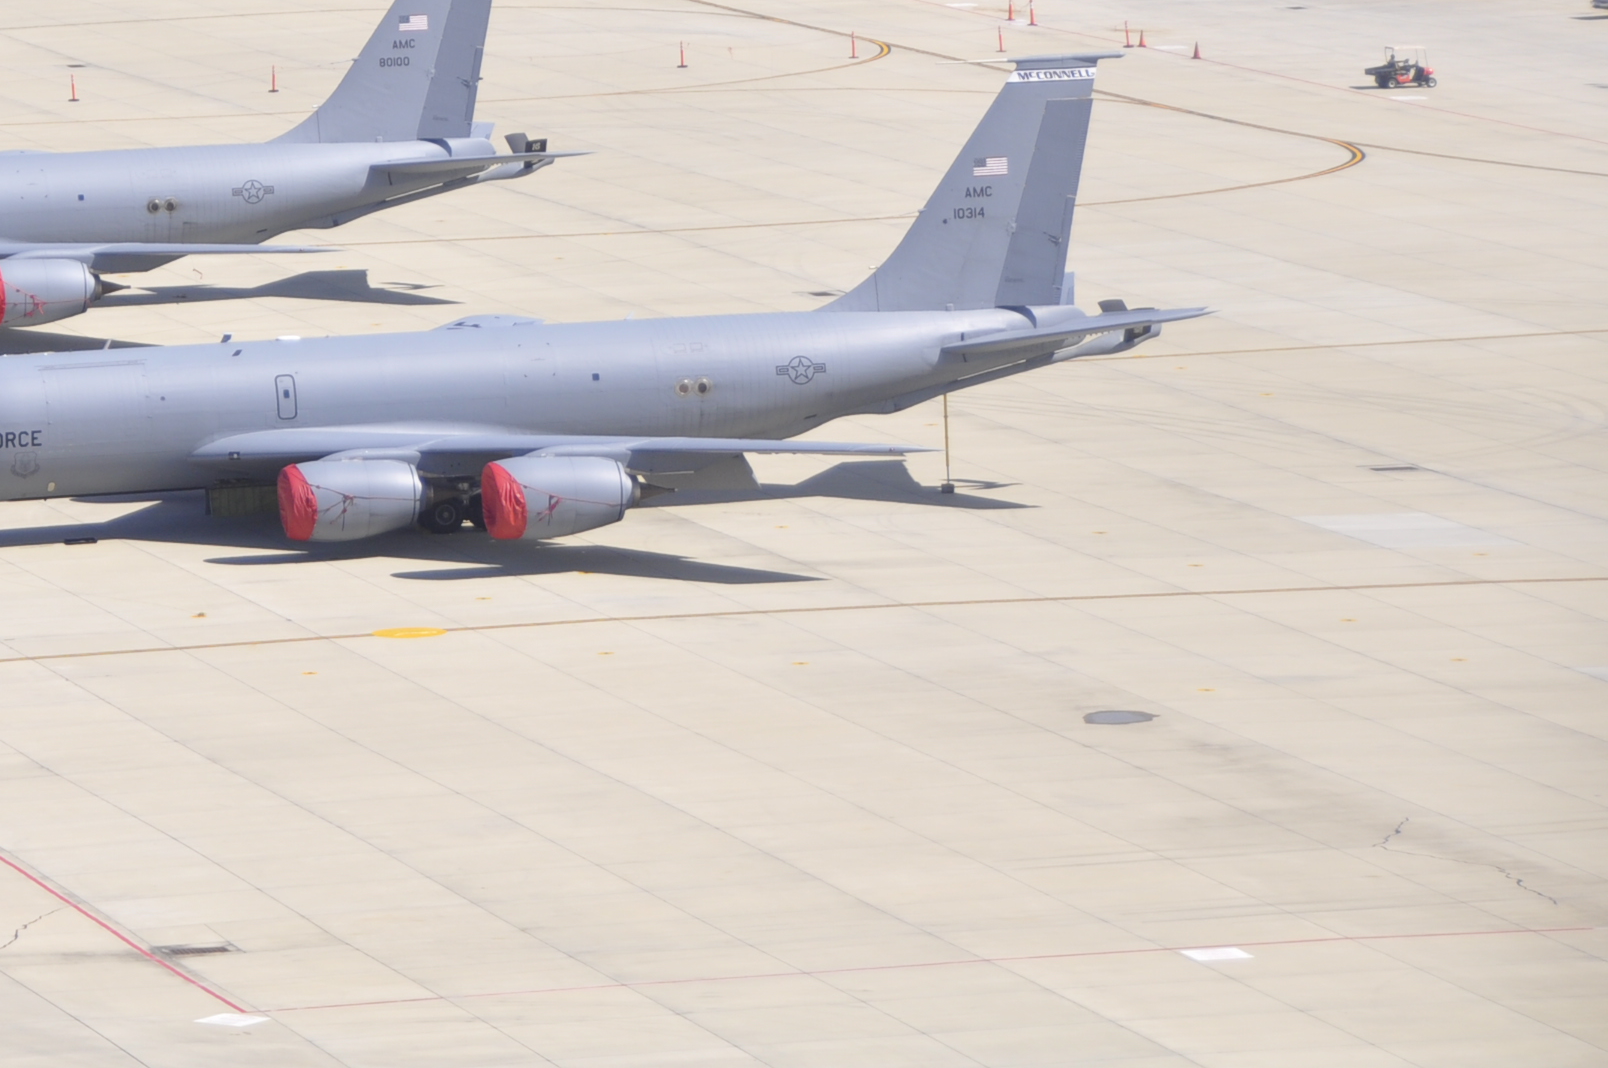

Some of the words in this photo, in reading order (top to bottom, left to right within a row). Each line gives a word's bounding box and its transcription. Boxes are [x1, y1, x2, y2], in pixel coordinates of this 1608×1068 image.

[392, 38, 416, 50] AMC
[379, 56, 410, 68] 80100
[964, 186, 993, 198] AMC
[953, 207, 985, 220] 10314
